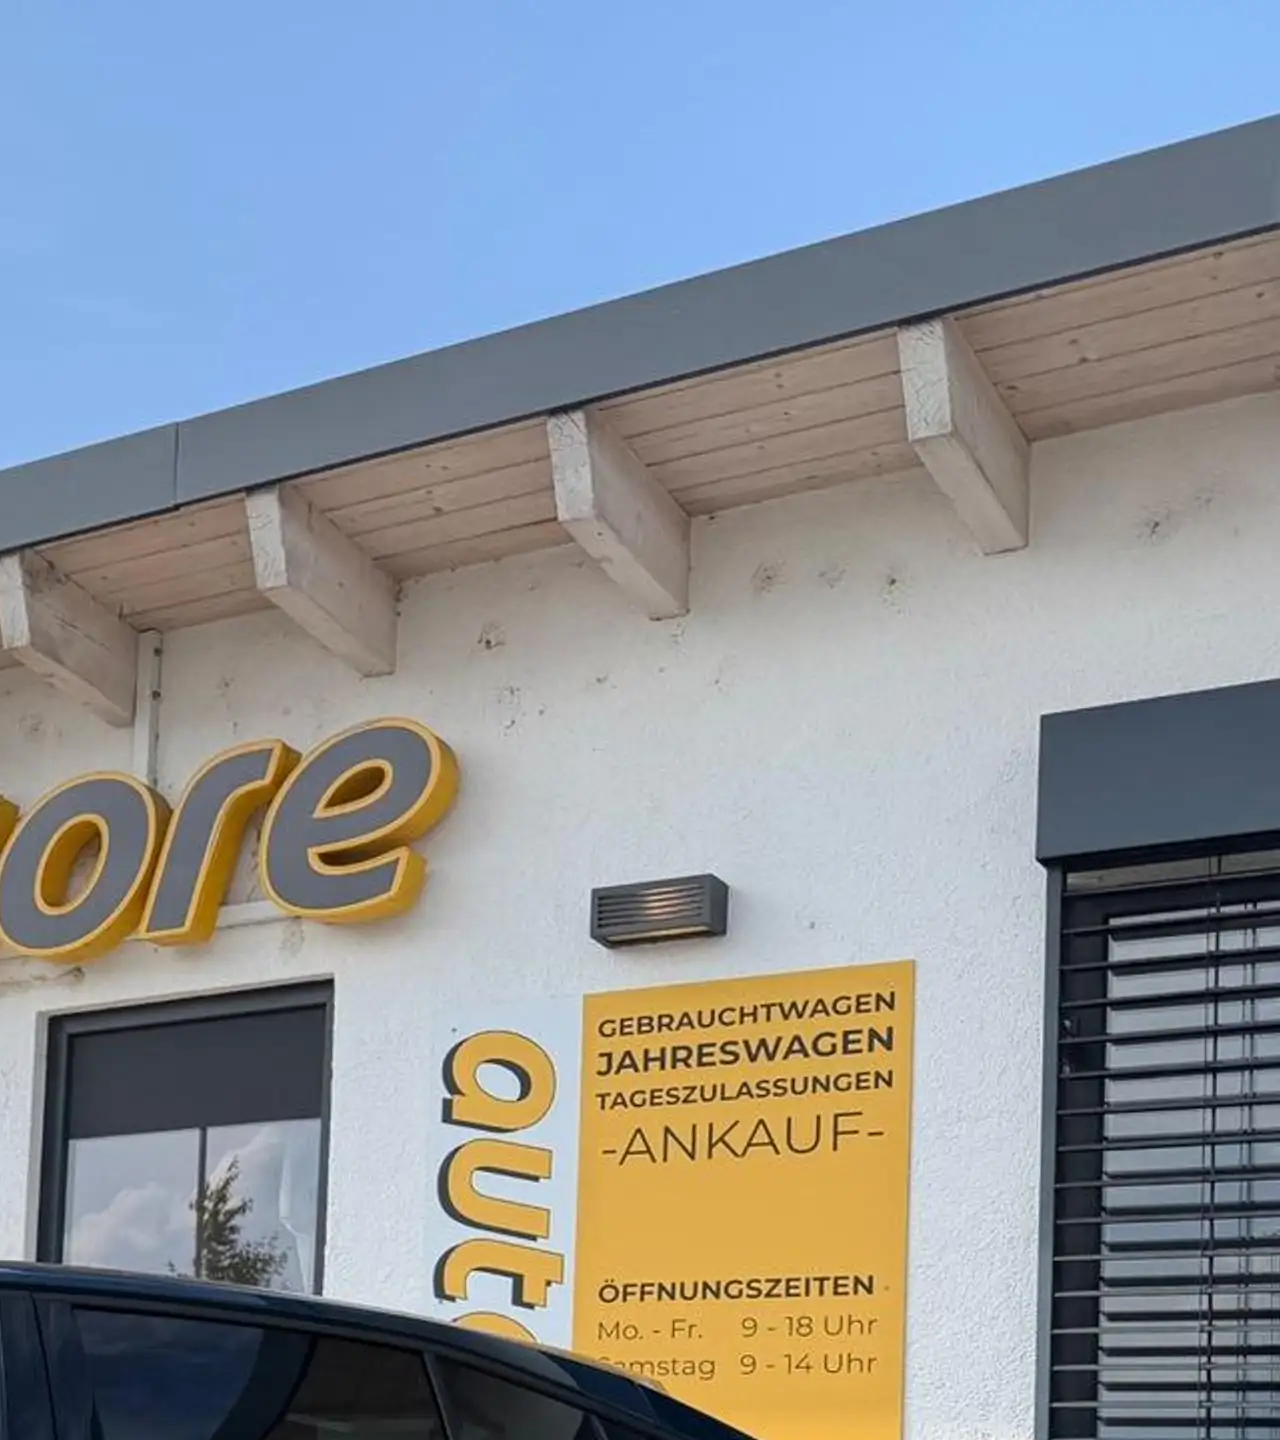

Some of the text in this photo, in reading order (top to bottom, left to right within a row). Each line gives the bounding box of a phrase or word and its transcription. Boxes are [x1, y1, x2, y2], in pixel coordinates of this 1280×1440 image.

[597, 991, 896, 1038] GEBRAUCHTWAGEN
[596, 1026, 894, 1076] JAHRESWAGEN
[595, 1070, 894, 1110] TAGESZULASSUNGEN
[602, 1111, 884, 1166] -ANKAUF-
[598, 1275, 874, 1303] ÖFFNUNGSZEITEN
[597, 1321, 643, 1341] Mo.
[670, 1318, 703, 1339] Fr.
[741, 1316, 758, 1337] 9
[784, 1315, 814, 1337] 18
[823, 1313, 879, 1336] Uhr
[739, 1354, 757, 1375] 9
[783, 1353, 812, 1375] 14
[823, 1351, 878, 1374] Uhr
